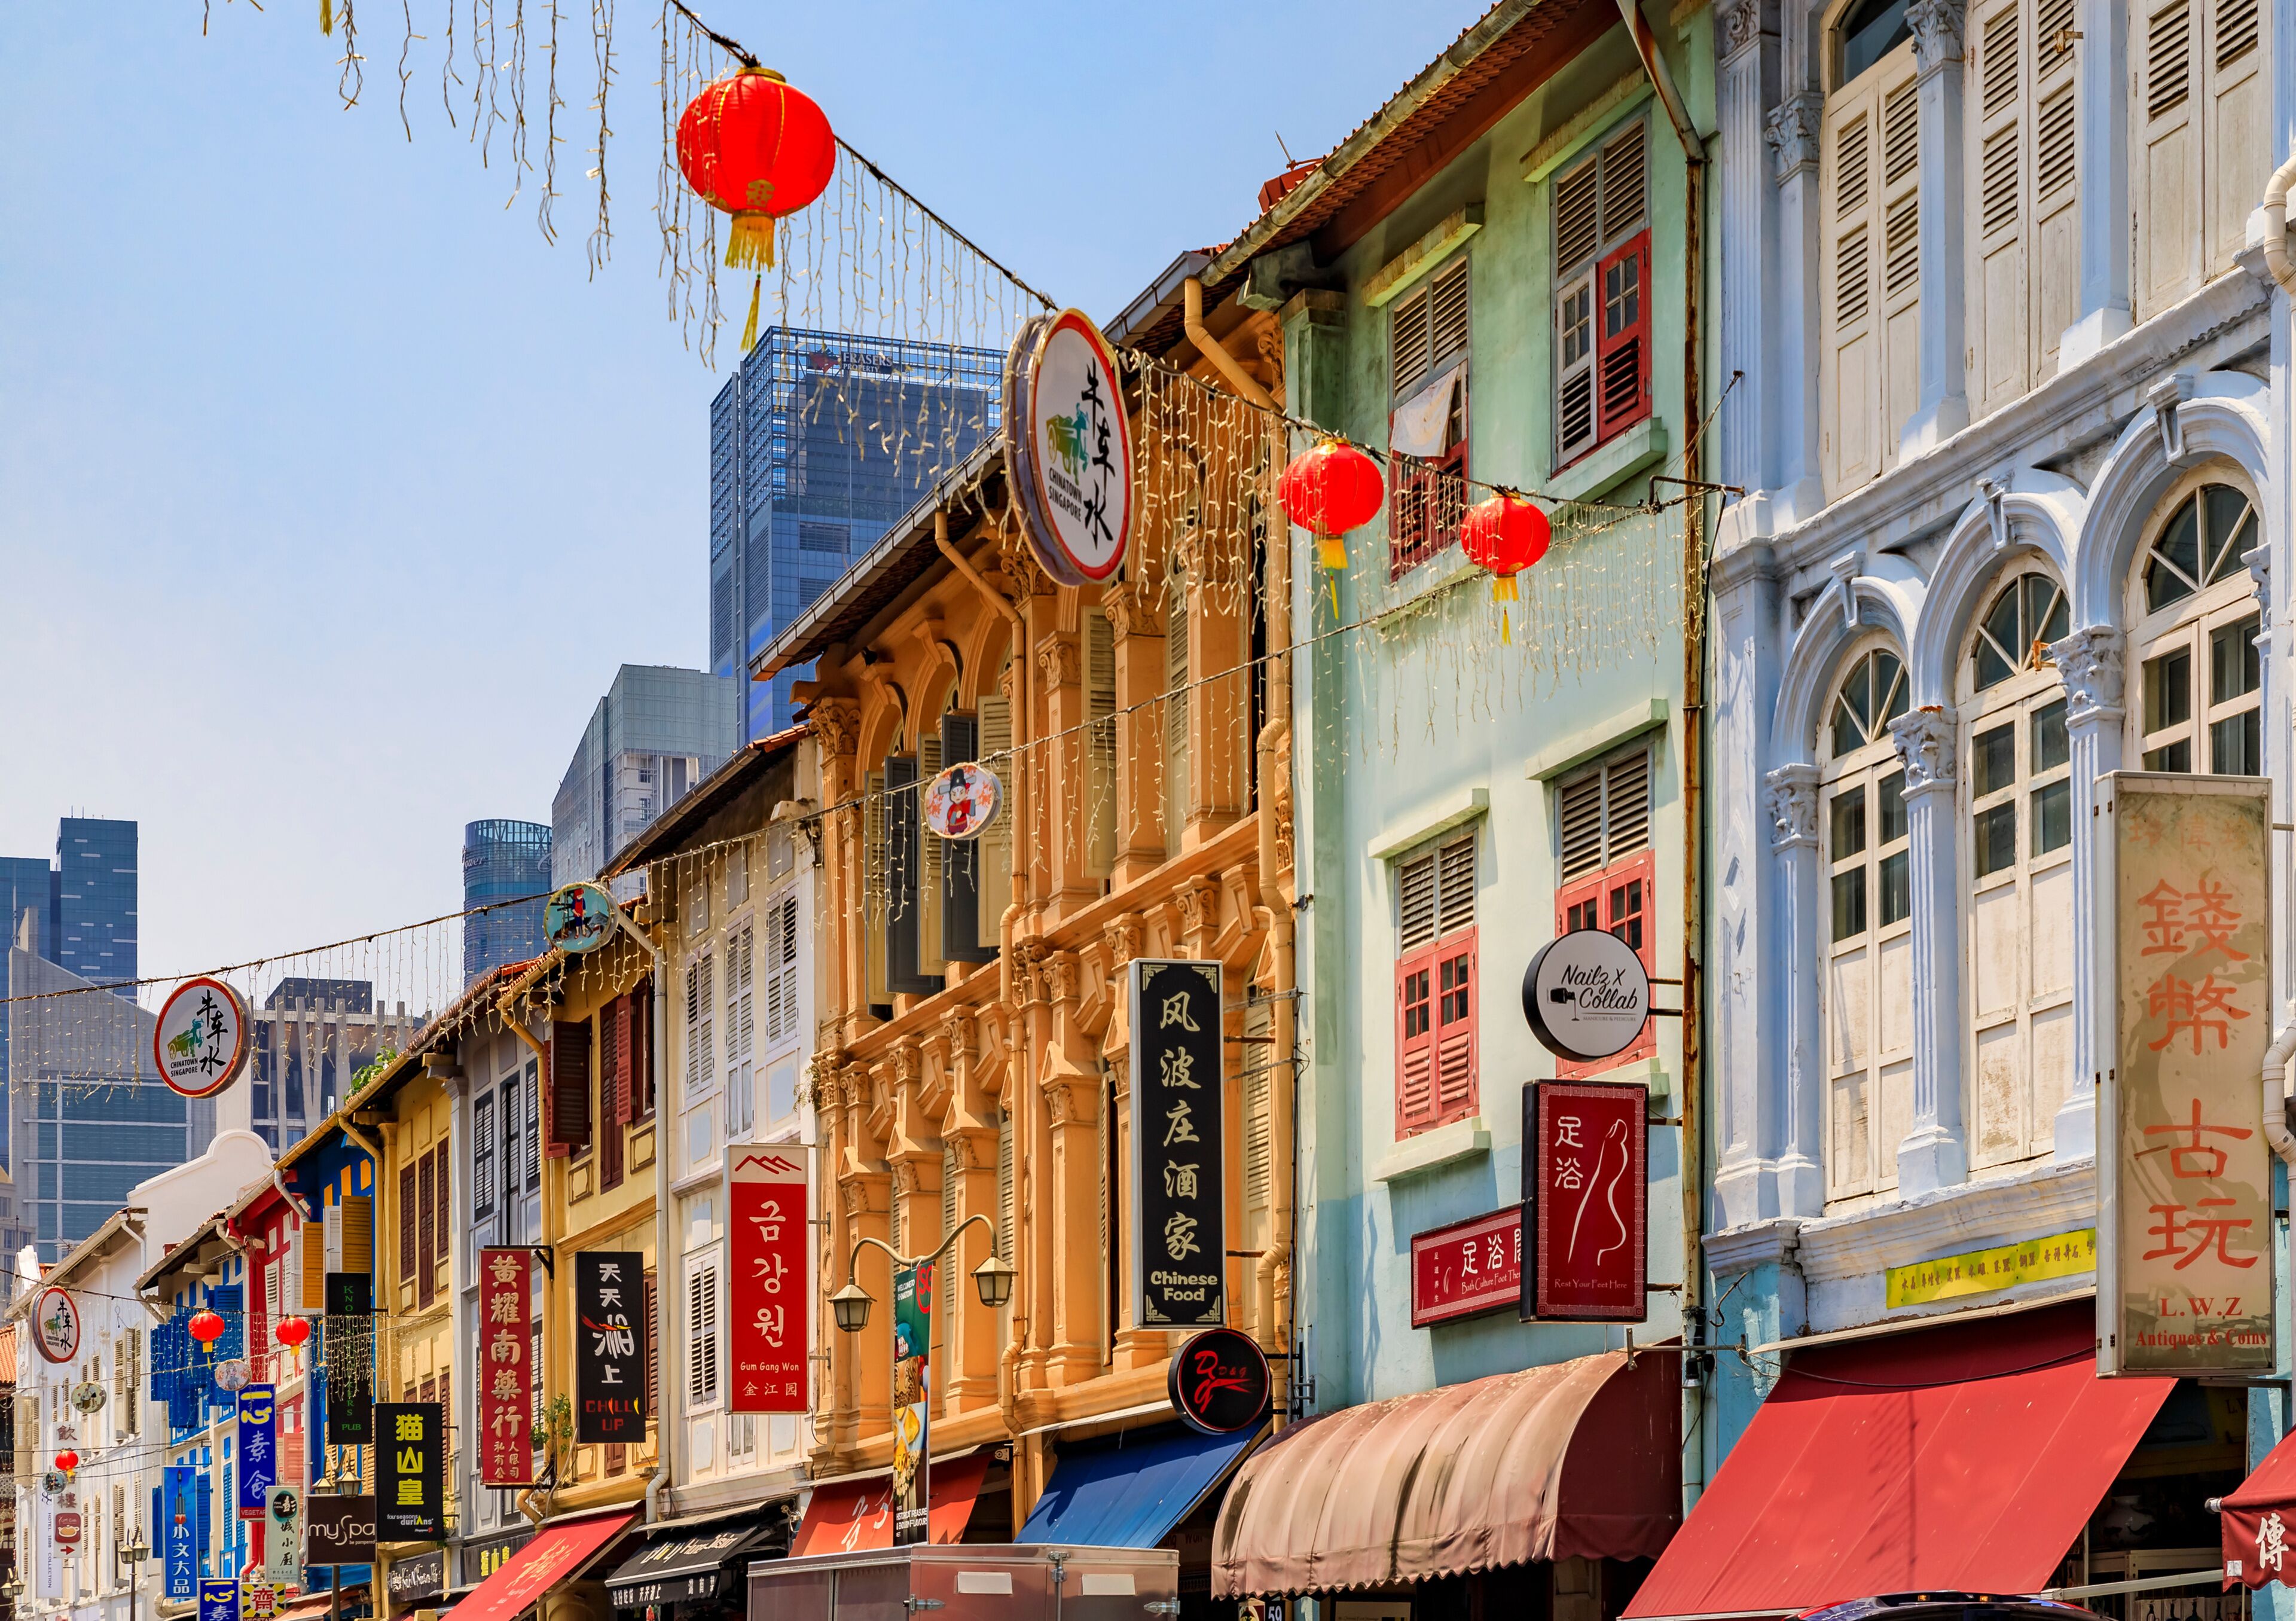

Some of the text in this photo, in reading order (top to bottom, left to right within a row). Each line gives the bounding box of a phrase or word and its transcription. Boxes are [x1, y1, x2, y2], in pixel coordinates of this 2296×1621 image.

[842, 352, 893, 367] FRASERS
[842, 363, 880, 374] PROPERTY
[1081, 357, 1116, 550] 牛车水
[1049, 466, 1082, 505] CHINATOWN
[1048, 485, 1082, 523] SINGAPORE
[1561, 964, 1610, 995] Nailz
[1579, 987, 1638, 1009] Collab
[196, 989, 228, 1077] 牛车水
[170, 1058, 198, 1069] CHINATOWN
[170, 1066, 198, 1077] SINGAPORE
[1160, 991, 1201, 1261] 风波庄酒家
[1555, 1116, 1583, 1189] 足浴
[749, 1200, 788, 1348] 금강원
[1151, 1271, 1218, 1286] Chinese
[1461, 1281, 1474, 1295] Bath
[1474, 1277, 1494, 1290] Culture
[1494, 1273, 1507, 1286] Foot
[1555, 1278, 1628, 1289] Rest Your Feet Here
[1164, 1287, 1205, 1302] Food
[57, 1296, 73, 1353] 牛车水
[2136, 1329, 2267, 1350] Antiques & Coins
[740, 1361, 799, 1374] Gum Gang Won
[743, 1381, 797, 1397] 金江园
[341, 1423, 361, 1431] PUB
[602, 1419, 624, 1431] UP
[396, 1414, 424, 1505] 猫山皇
[309, 1515, 375, 1546] mySpa
[2255, 1512, 2289, 1571] 傳
[172, 1524, 190, 1594] 小文大品
